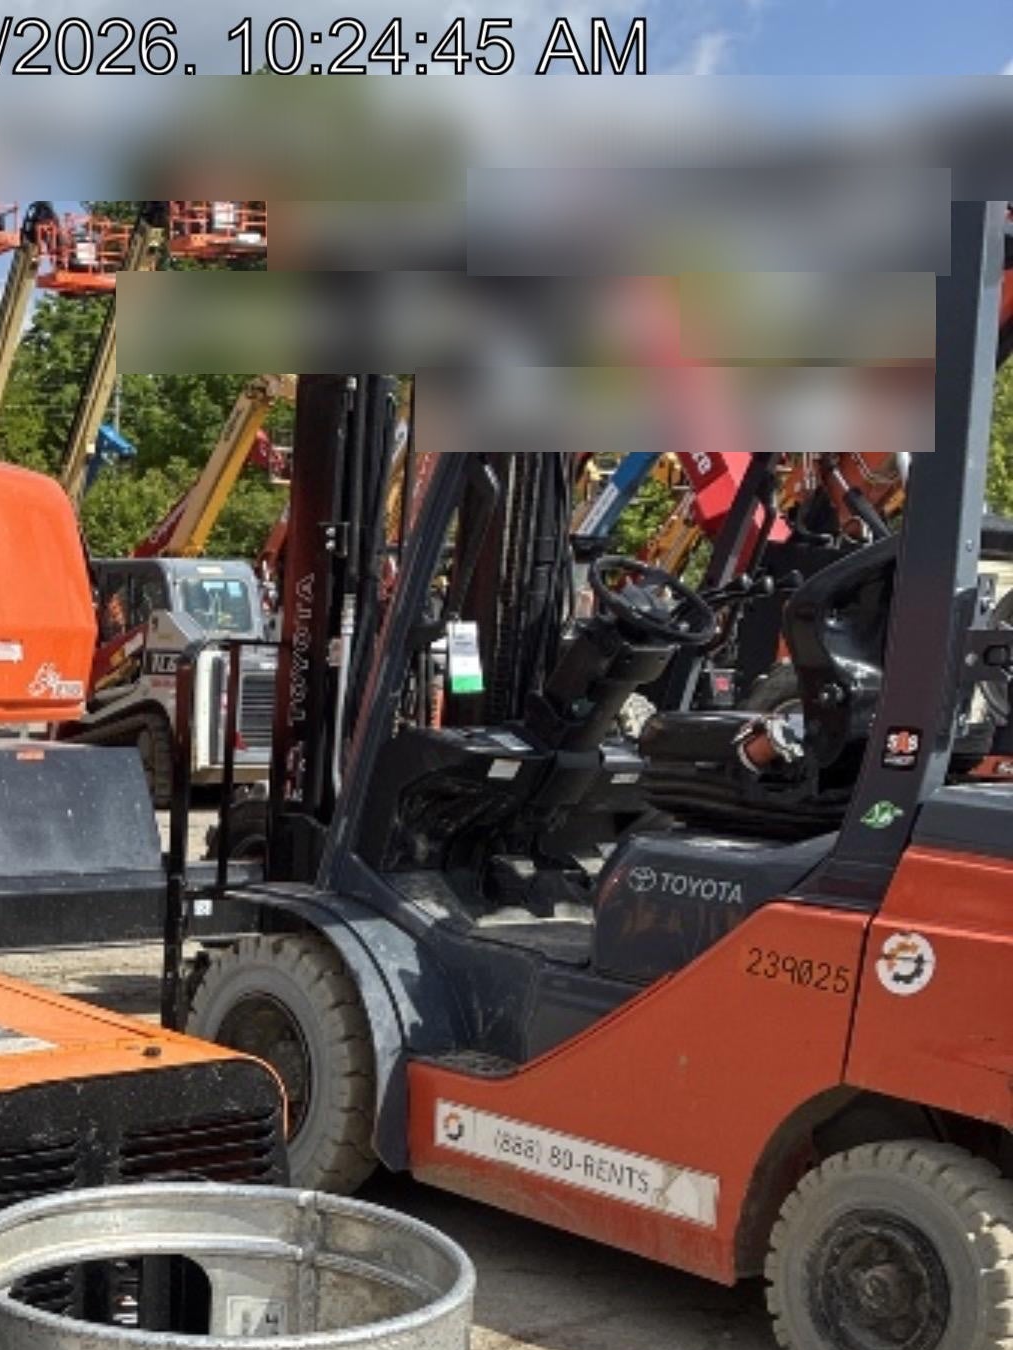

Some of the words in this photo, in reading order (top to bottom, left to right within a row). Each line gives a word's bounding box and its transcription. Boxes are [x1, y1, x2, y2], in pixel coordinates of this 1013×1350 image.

[289, 573, 316, 727] TOYOTA
[661, 872, 743, 903] TOYOTA
[746, 947, 851, 994] 239025
[494, 1128, 544, 1165] (888)
[548, 1145, 652, 1195] 80-RENTS
